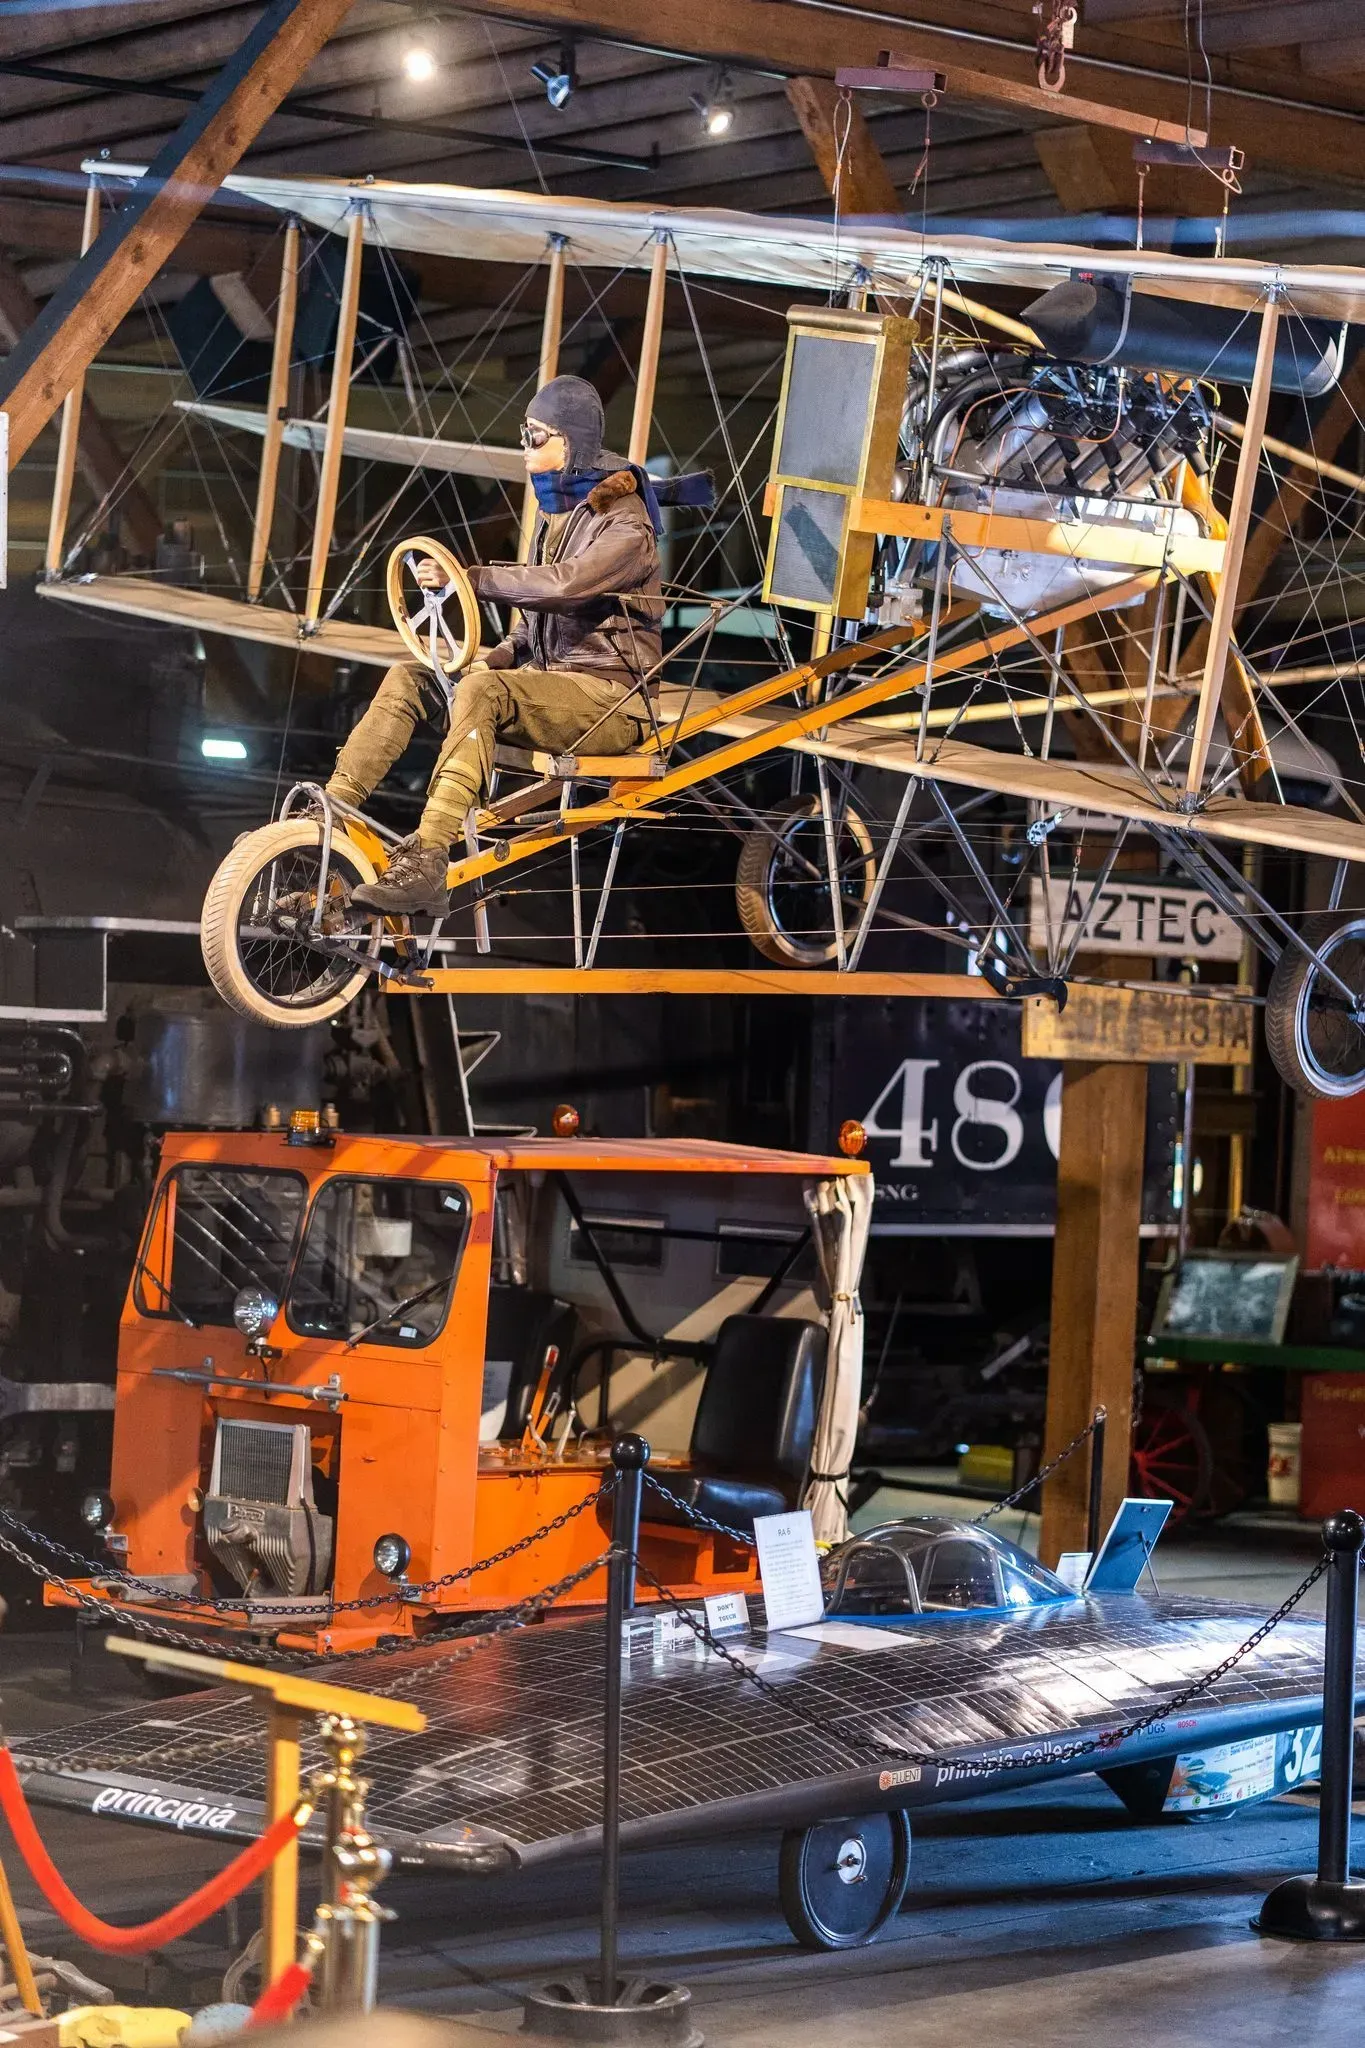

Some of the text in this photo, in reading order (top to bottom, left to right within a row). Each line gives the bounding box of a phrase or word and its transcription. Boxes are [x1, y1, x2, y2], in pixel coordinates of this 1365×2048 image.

[1063, 889, 1219, 946] AZTEC
[861, 1058, 1063, 1171] 48
[716, 1602, 734, 1612] DON'T
[718, 1613, 737, 1622] TOUCH
[1147, 1722, 1166, 1735] UGS
[1177, 1719, 1197, 1729] BOSCH
[891, 1767, 921, 1785] FLUENT
[91, 1787, 238, 1830] principia
